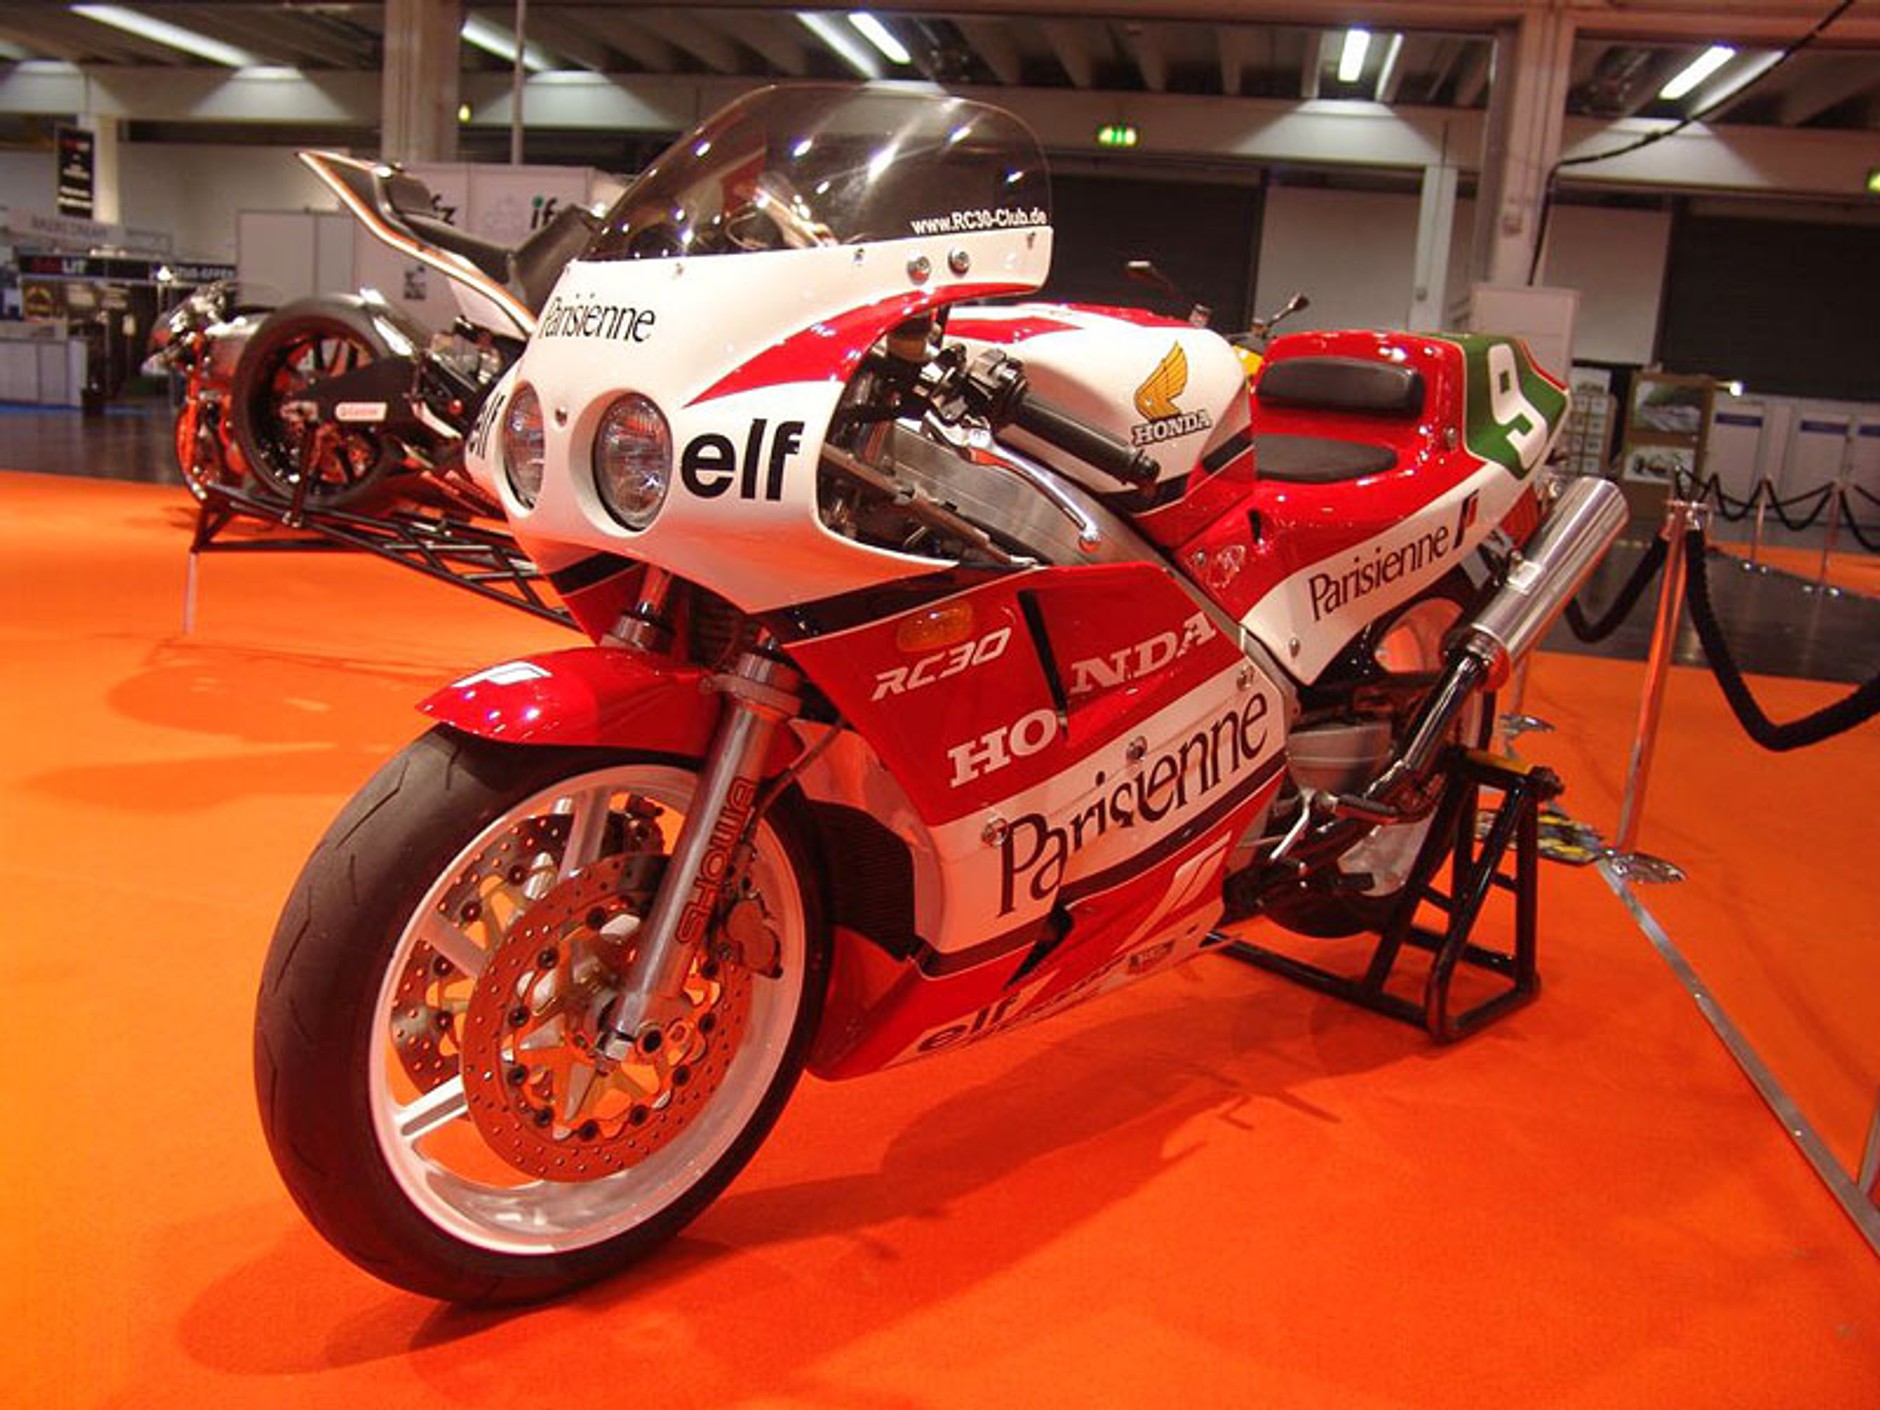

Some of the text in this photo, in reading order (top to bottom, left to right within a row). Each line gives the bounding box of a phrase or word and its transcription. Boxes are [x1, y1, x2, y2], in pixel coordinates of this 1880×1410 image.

[530, 196, 559, 230] if
[910, 206, 1048, 235] www.RC30-Club.de
[538, 292, 656, 343] Parisienne
[1131, 410, 1212, 446] HONDA
[1488, 343, 1549, 470] 9
[680, 418, 804, 501] elf
[1308, 522, 1450, 621] Parisienne
[871, 627, 1013, 701] RC30
[675, 776, 756, 943] SHOWA
